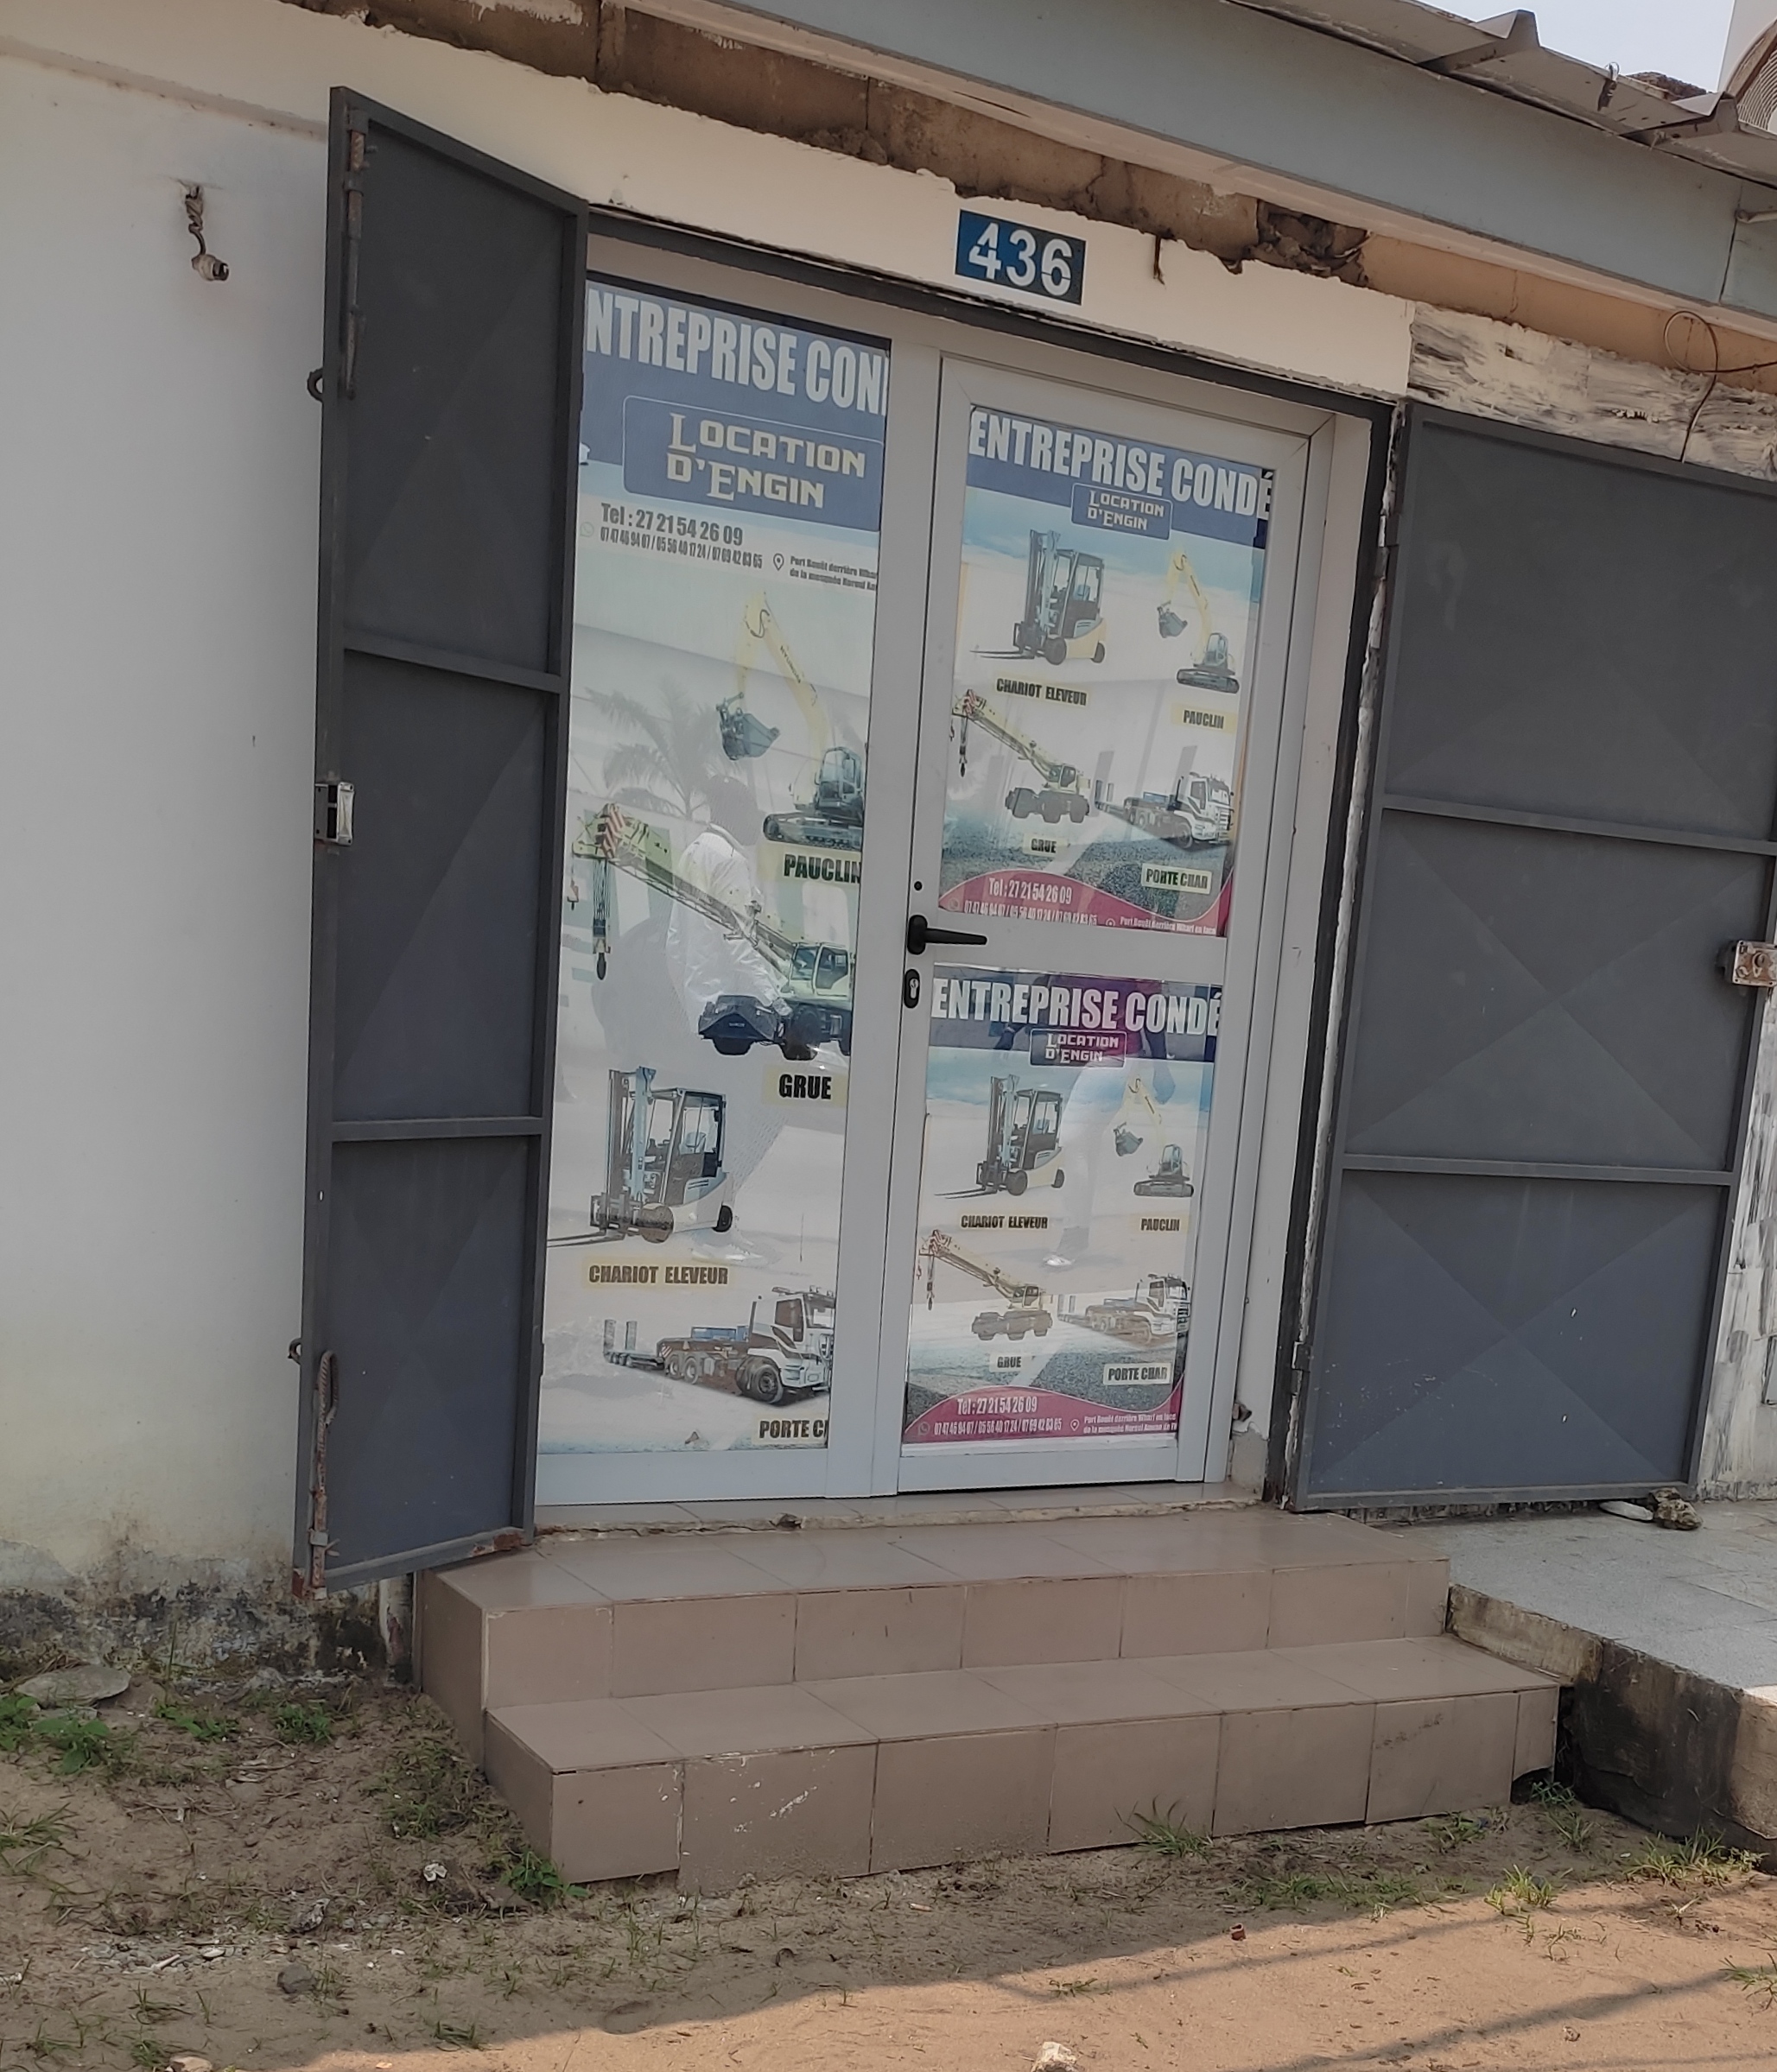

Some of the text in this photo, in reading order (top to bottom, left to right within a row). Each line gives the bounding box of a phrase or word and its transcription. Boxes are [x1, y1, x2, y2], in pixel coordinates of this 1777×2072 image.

[968, 222, 1072, 296] 436
[805, 339, 890, 416] CON
[669, 412, 866, 478] LOCATION
[968, 410, 1273, 521] ENTREPRISE CONDÉ
[666, 452, 825, 509] D'ENGIN
[1088, 489, 1165, 518] LOCATION
[600, 502, 625, 526] Tel
[636, 509, 654, 530] 27
[657, 513, 673, 534] 21
[676, 516, 697, 539] 54
[700, 521, 720, 542] 26
[723, 525, 743, 547] 09
[1087, 506, 1148, 531] D'ENGIN
[996, 678, 1088, 707] CHARIOT ELEVEUR
[1183, 709, 1225, 730] PAUCLIN
[1031, 838, 1057, 853] GRUE
[1146, 868, 1209, 890] PORTE CHAR
[1008, 880, 1020, 898] 27
[1021, 882, 1031, 899] 21
[1032, 884, 1046, 902] 54
[1046, 884, 1059, 903] 26
[1059, 886, 1073, 905] 09
[931, 978, 1222, 1036] ENTREPRISE CONDÉ
[1047, 1033, 1119, 1049] LOCATION
[1045, 1048, 1103, 1064] D'ENGIN
[778, 1074, 832, 1100] GRUE
[961, 1215, 1049, 1229] CHARIOT ELEVEUR
[1140, 1218, 1181, 1232] PAUCLIN
[588, 1264, 729, 1285] CHARIOT ELEVEUR
[997, 1356, 1022, 1368] GRUE
[1107, 1366, 1168, 1381] PORTE CHAR
[976, 1398, 987, 1415] 27
[987, 1397, 998, 1415] 21
[999, 1397, 1011, 1414] 54
[1012, 1397, 1025, 1413] 26
[1025, 1396, 1038, 1413] 09
[758, 1420, 810, 1439] PORTE
